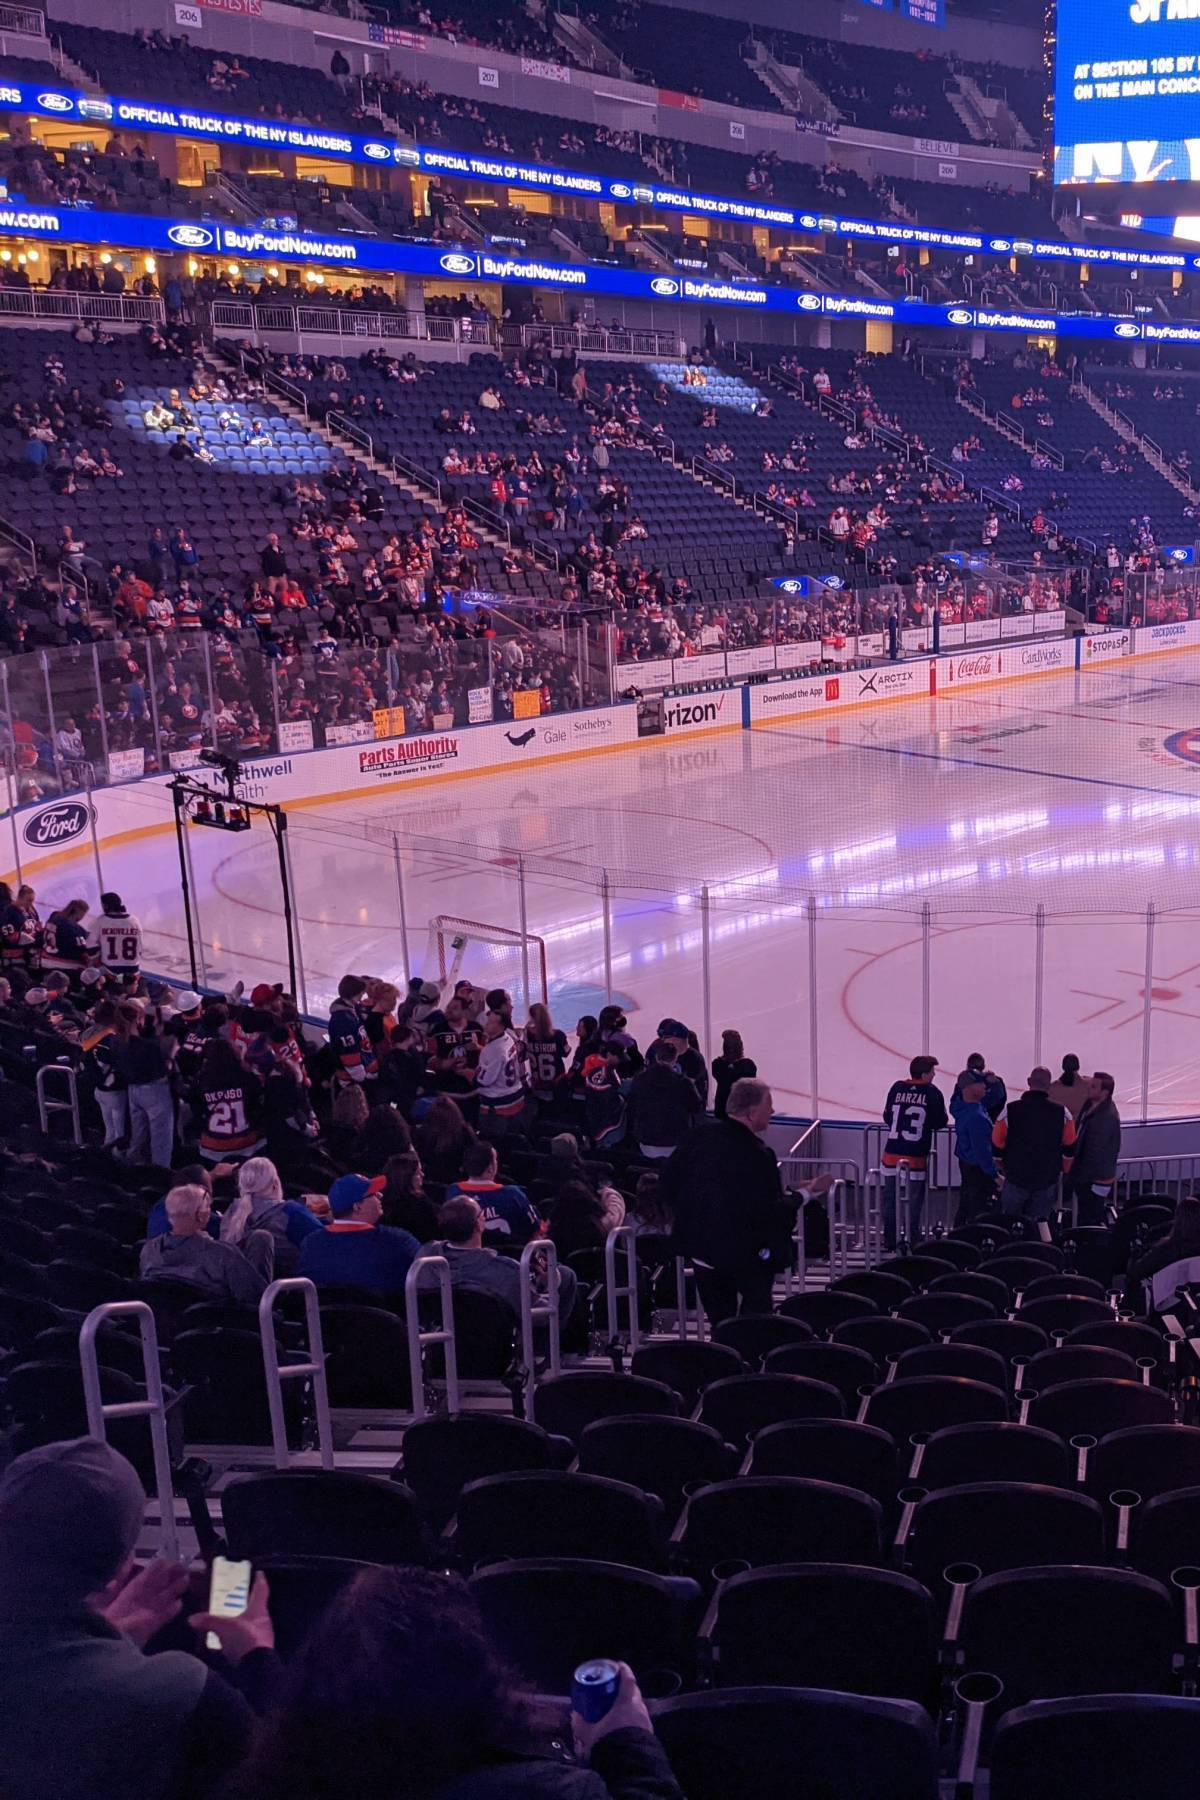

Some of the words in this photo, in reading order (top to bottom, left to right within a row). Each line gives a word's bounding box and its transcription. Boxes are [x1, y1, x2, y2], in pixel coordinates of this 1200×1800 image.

[180, 10, 197, 22] 206
[482, 73, 495, 82] 207
[1074, 64, 1090, 80] AT
[1092, 61, 1147, 78] SECTION
[1177, 57, 1195, 72] BY
[1074, 83, 1093, 100] ON
[1096, 82, 1120, 98] THE
[1123, 79, 1155, 96] MAIN
[119, 106, 178, 126] OFFICIAL
[180, 114, 223, 134] TRUCK
[224, 120, 242, 135] OF
[244, 124, 269, 140] THE
[268, 127, 288, 143] NY
[289, 131, 352, 153] ISLANDERS
[920, 140, 954, 153] BELIEVE
[424, 153, 470, 171] OFFICIAL
[470, 161, 502, 177] TRUCK
[504, 166, 518, 179] OF
[519, 169, 538, 183] THE
[538, 172, 552, 184] NY
[553, 174, 601, 193] ISLANDERS
[657, 192, 691, 207] OFFICIAL
[692, 198, 716, 212] TRUCK
[718, 202, 728, 212] OF
[730, 204, 744, 215] THE
[746, 206, 755, 216] NY
[756, 208, 794, 224] ISLANDERS
[840, 221, 875, 234] OFFICIAL
[876, 226, 902, 238] TRUCK
[903, 230, 914, 240] OF
[914, 231, 930, 242] THE
[930, 232, 940, 243] NY
[942, 235, 982, 247] ISLANDERS
[225, 231, 356, 259] BuyFordNow.com
[1036, 244, 1070, 256] OFFICIAL
[1073, 248, 1098, 259] TRUCK
[1100, 250, 1110, 260] OF
[1112, 252, 1126, 262] THE
[1128, 253, 1138, 263] NY
[1140, 254, 1185, 266] ISLANDERS
[484, 259, 586, 283] BuyFordNow.com
[685, 282, 766, 302] BuyFordNow.com
[826, 298, 894, 316] BuyFordNow.com
[979, 313, 1056, 330] BuyFordNow.com
[1022, 648, 1062, 665] CardWorks
[878, 672, 913, 684] ARCTIX
[763, 691, 797, 703] Download
[797, 689, 809, 698] the
[810, 688, 823, 698] App
[544, 730, 567, 744] Gale
[359, 747, 395, 765] Parts
[397, 737, 457, 760] Authority
[31, 803, 85, 843] Ford
[106, 937, 138, 960] 18
[340, 1034, 355, 1047] 13
[895, 1092, 927, 1106] BARZAL
[208, 1100, 250, 1134] 21
[888, 1104, 926, 1142] 13
